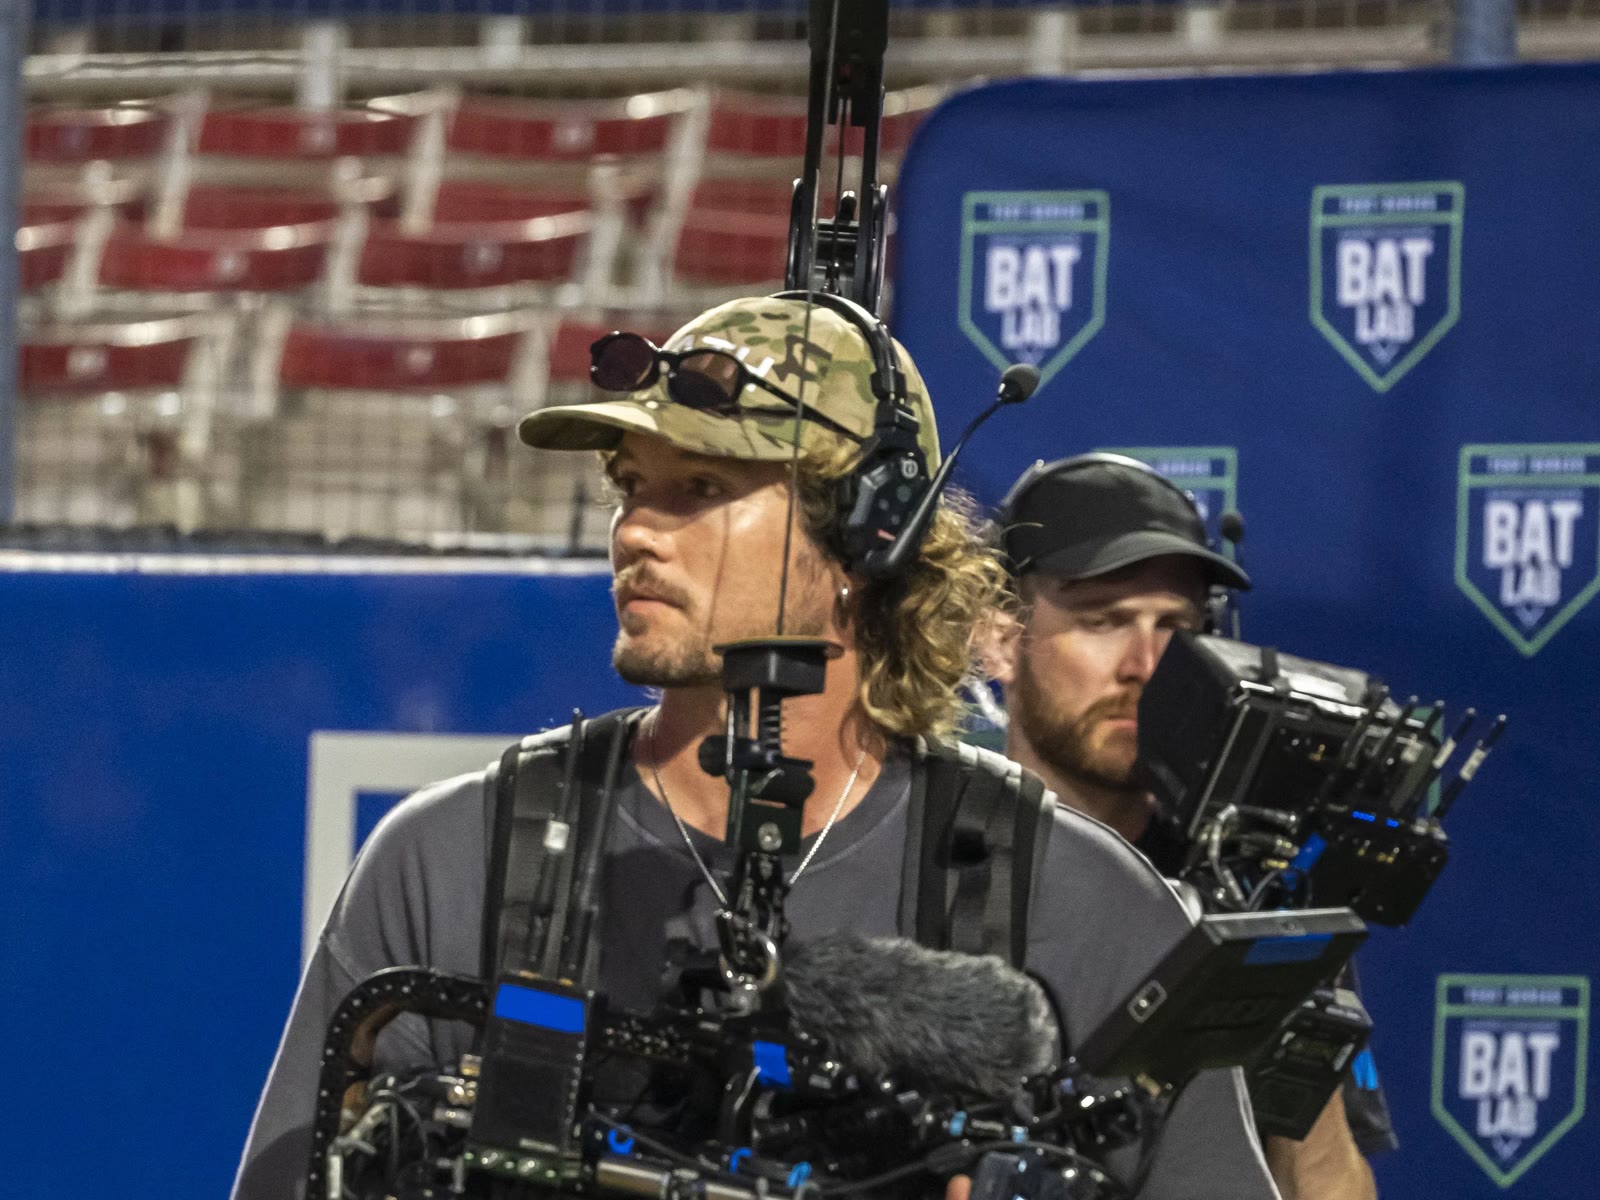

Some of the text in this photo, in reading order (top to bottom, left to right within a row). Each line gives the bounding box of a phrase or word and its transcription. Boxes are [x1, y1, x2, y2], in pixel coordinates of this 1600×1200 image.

[984, 245, 1081, 313] BAT
[1336, 237, 1434, 307] BAT
[1002, 307, 1060, 350] LAB
[1355, 301, 1414, 344] LAB
[1483, 499, 1583, 569] BAT
[1501, 562, 1561, 607] LAB
[1459, 1031, 1560, 1100] BAT
[1476, 1095, 1538, 1138] LAB
